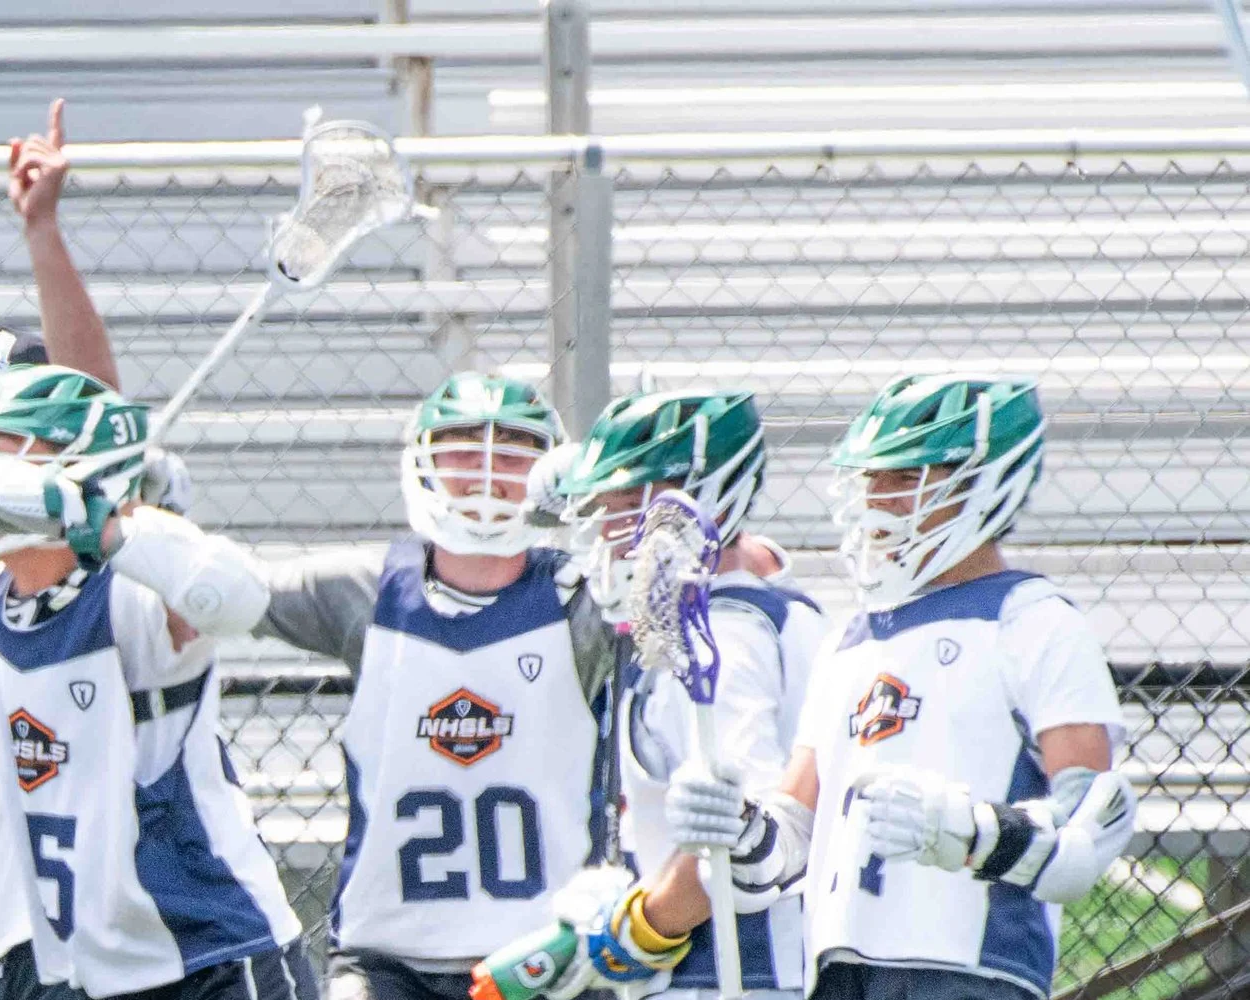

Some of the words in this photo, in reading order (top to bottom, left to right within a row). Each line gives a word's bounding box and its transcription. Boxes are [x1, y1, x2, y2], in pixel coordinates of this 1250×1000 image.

[109, 411, 138, 445] 31
[418, 715, 513, 739] NHSLS
[15, 737, 68, 764] SLS
[397, 785, 546, 899] 20
